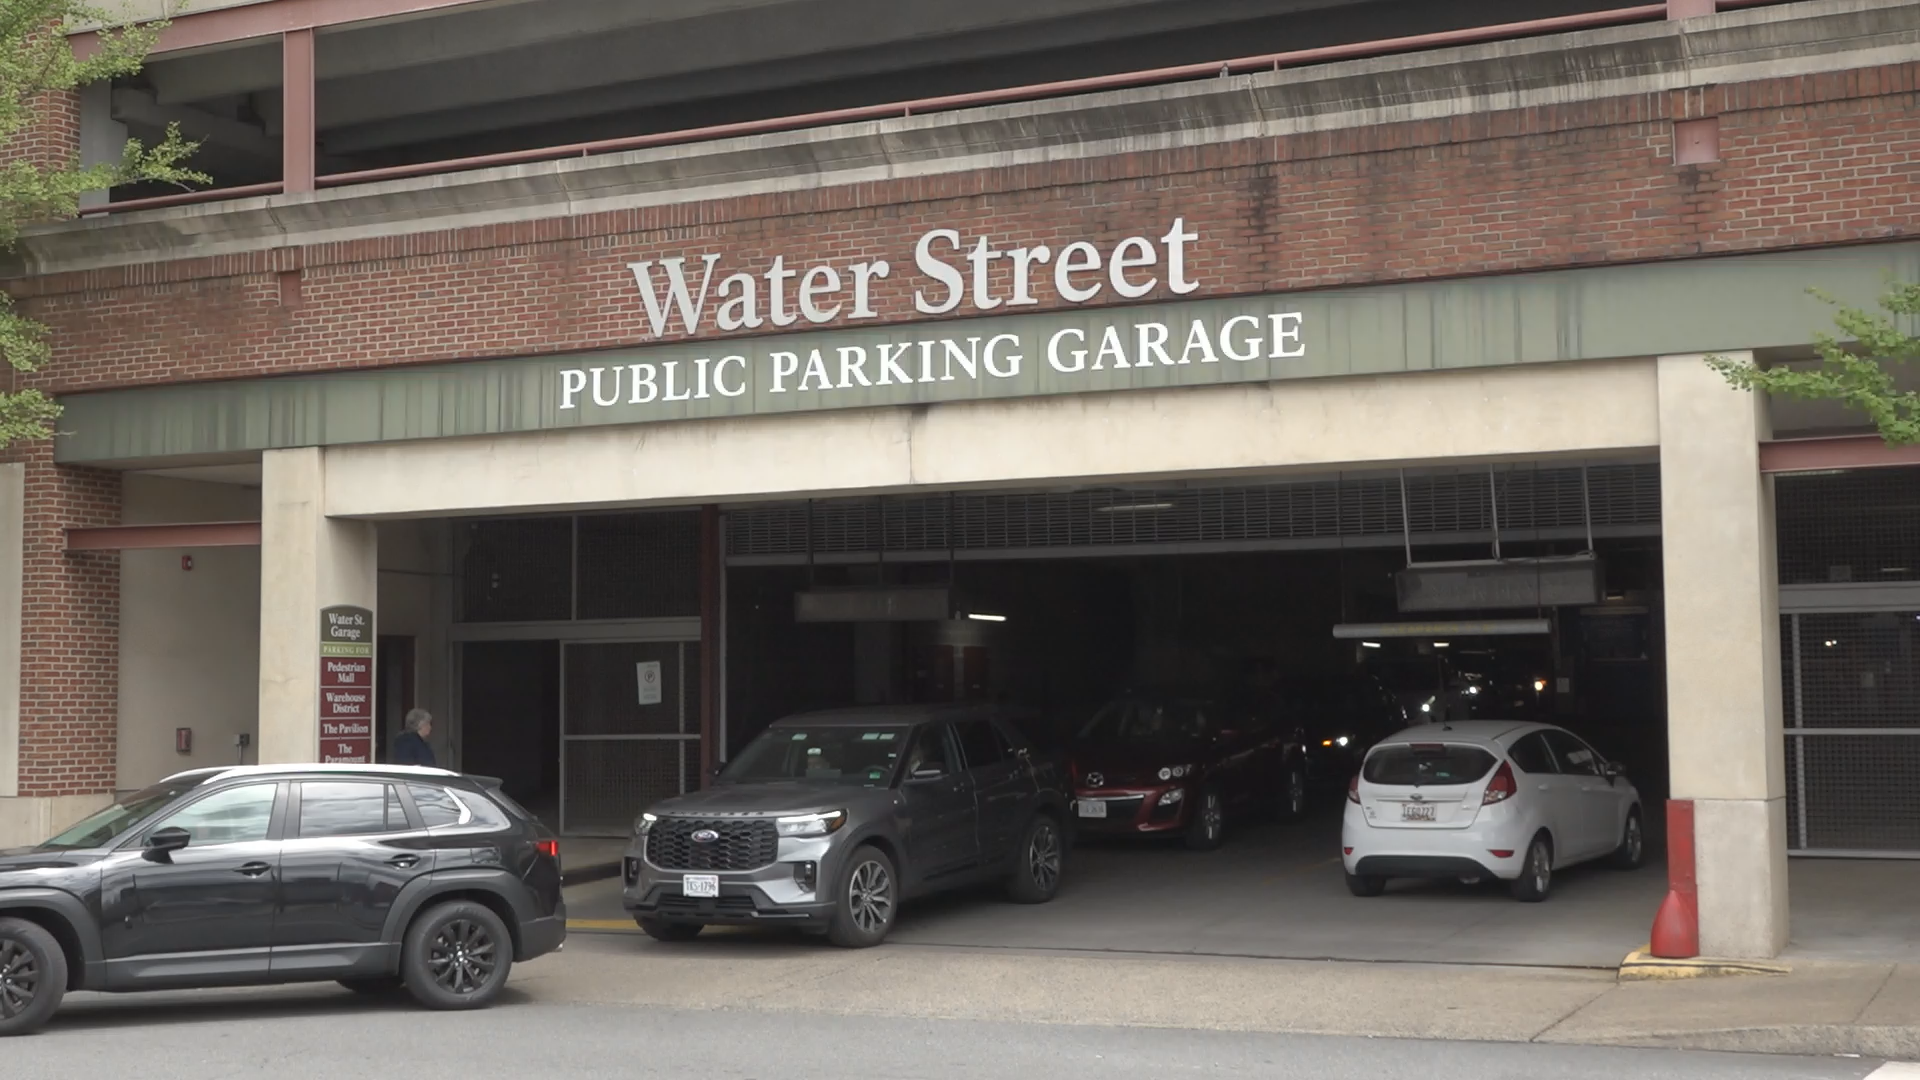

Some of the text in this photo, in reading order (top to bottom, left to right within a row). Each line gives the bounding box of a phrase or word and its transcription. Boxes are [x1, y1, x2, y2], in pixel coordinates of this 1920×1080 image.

[627, 217, 1200, 338] Water Street
[559, 311, 1306, 410] PUBLIC PARKING GARAGE
[328, 612, 365, 625] Water St.
[330, 625, 361, 641] Garage
[323, 645, 370, 654] PARKING FOR
[327, 661, 366, 672] Pedestrian
[337, 672, 355, 683] Mall
[326, 692, 366, 702] Warehouse
[332, 703, 360, 713] District
[323, 723, 369, 734] The Pavilion
[337, 743, 353, 754] The
